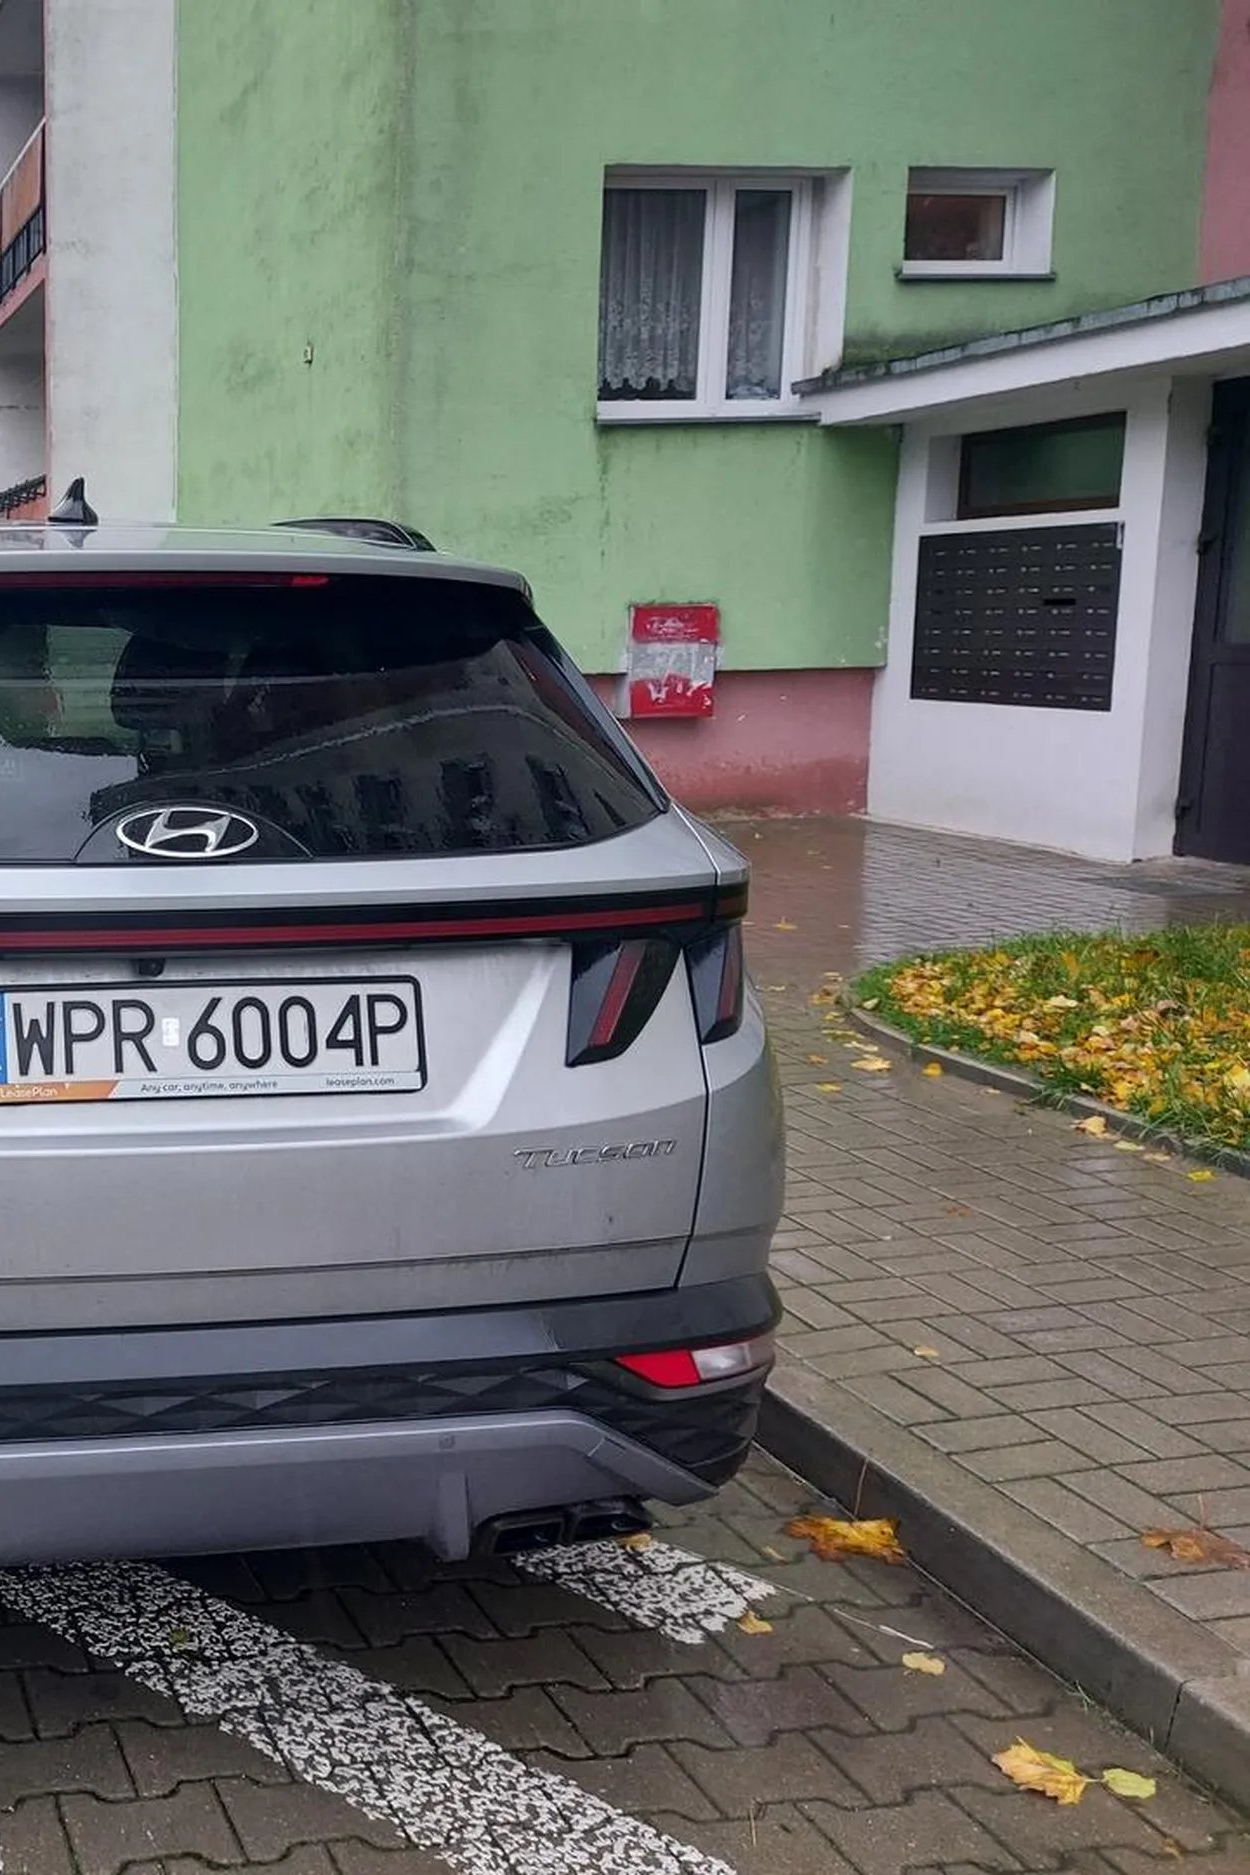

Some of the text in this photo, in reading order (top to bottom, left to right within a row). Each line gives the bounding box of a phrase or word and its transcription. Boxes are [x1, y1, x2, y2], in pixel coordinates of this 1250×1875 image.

[12, 993, 408, 1076] WPR 6004P
[140, 1083, 162, 1094] Any
[228, 1079, 279, 1091] anywhere
[326, 1075, 395, 1087] leaseplan.com
[0, 1086, 58, 1099] LeasePlan
